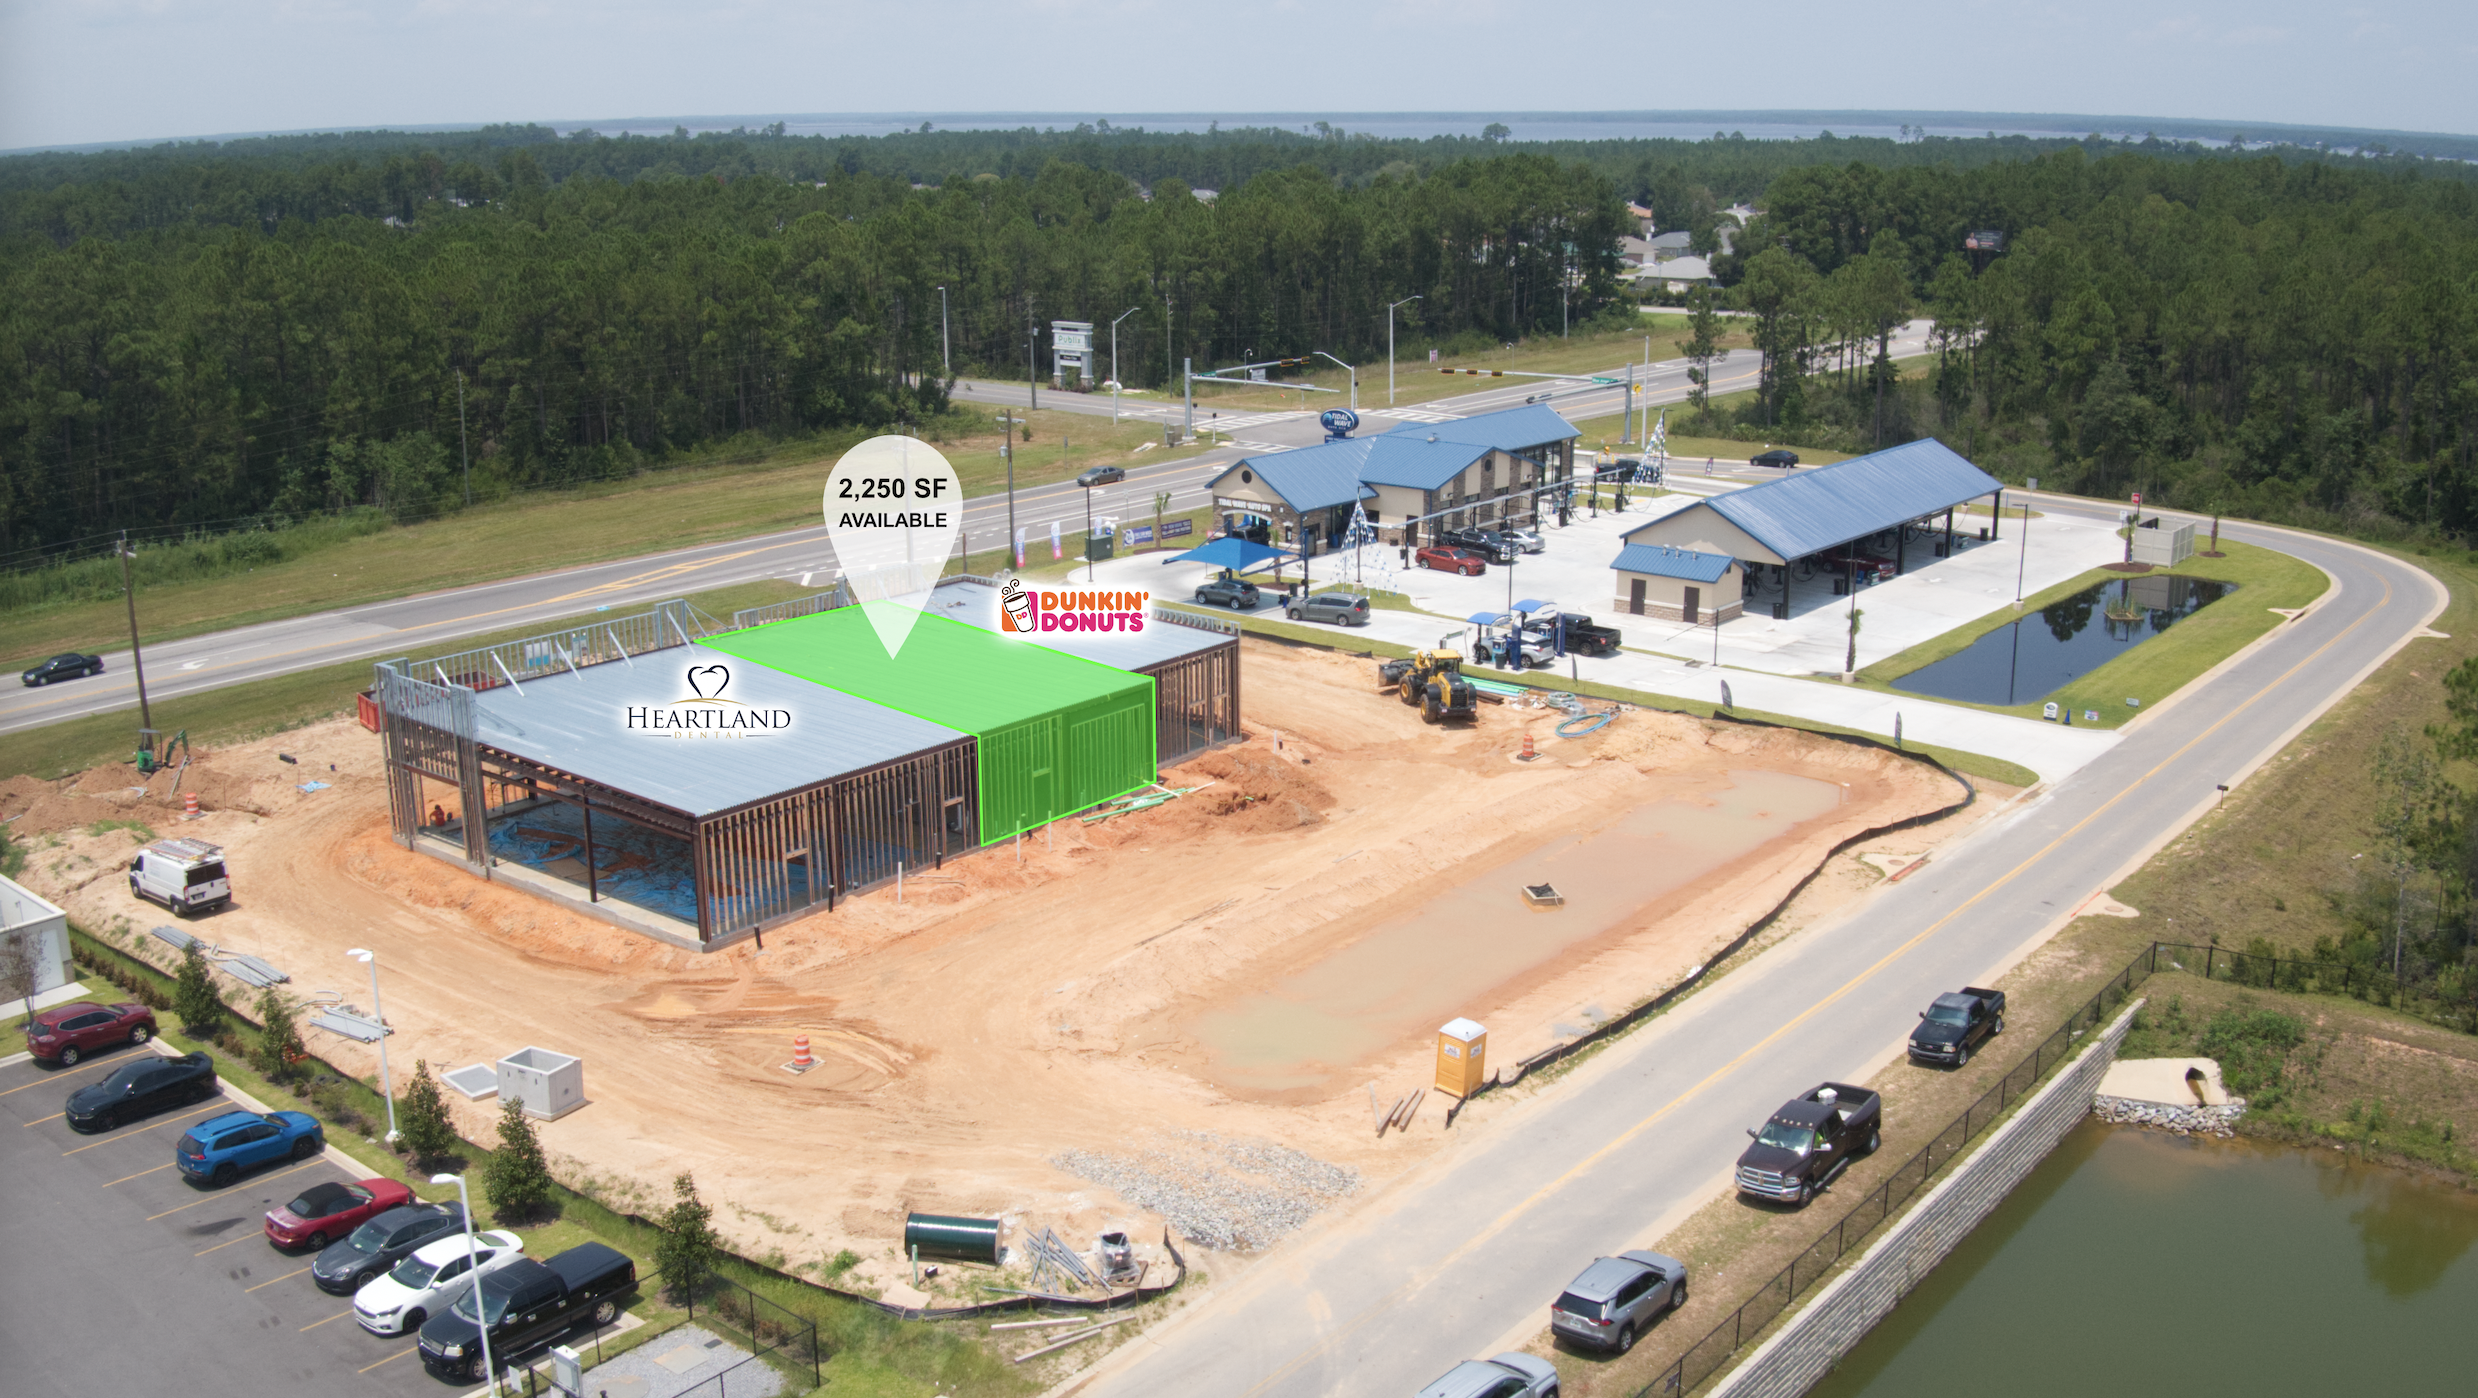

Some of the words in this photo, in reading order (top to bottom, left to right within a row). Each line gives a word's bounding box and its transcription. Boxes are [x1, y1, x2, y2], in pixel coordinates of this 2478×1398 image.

[1058, 334, 1081, 344] Publix
[1331, 413, 1348, 421] TIDAL
[1218, 498, 1232, 507] TIDAL
[1232, 500, 1247, 509] WAVE
[1247, 501, 1261, 511] AUTO
[1261, 503, 1272, 512] SPA
